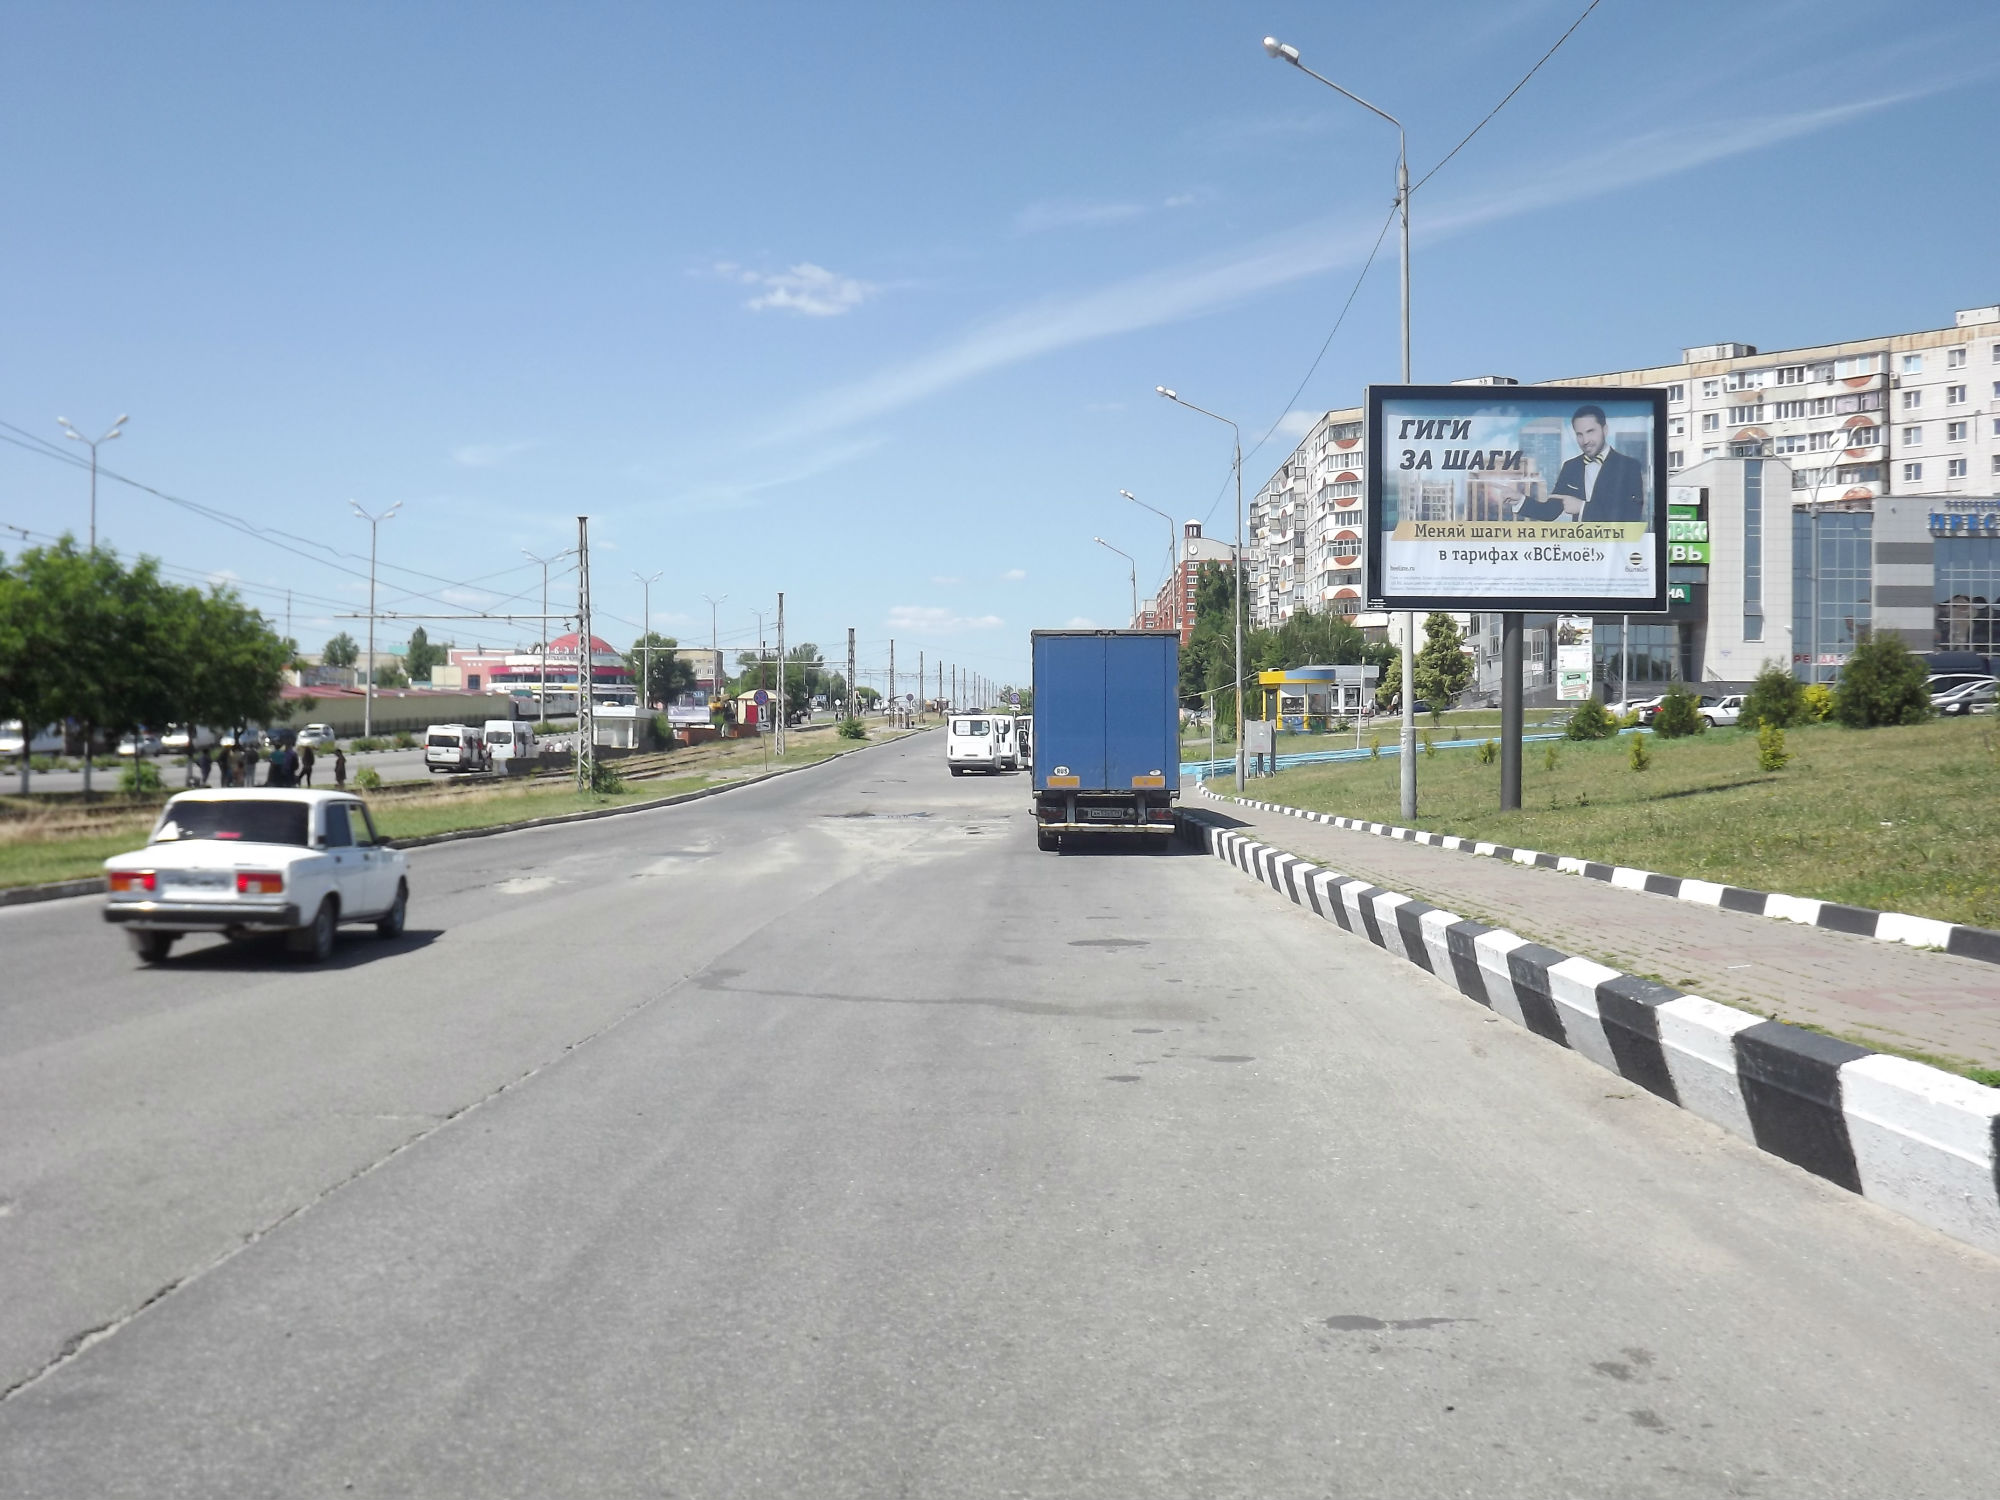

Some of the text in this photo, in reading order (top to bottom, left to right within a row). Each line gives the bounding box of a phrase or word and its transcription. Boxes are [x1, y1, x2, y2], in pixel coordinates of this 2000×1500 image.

[1398, 419, 1471, 440] ГИГИ
[1399, 449, 1523, 471] ЗА ШАГИ
[1414, 523, 1625, 539] Меняй шаги на гигабайты
[1438, 544, 1605, 565] в тарифах «ВСЁмоё!»
[1669, 545, 1702, 561] ВЬ
[1056, 767, 1069, 775] RUS
